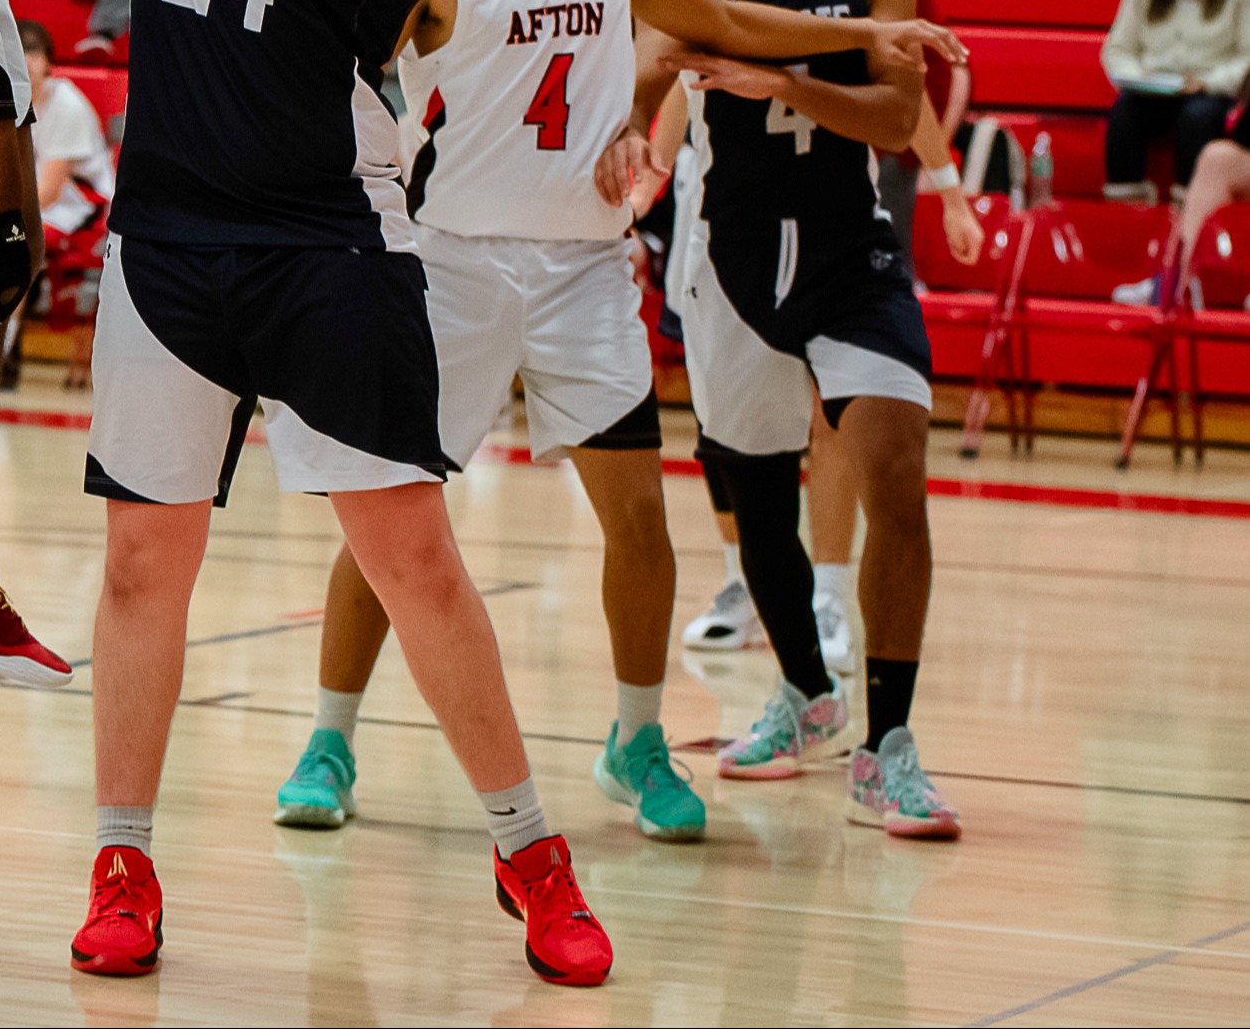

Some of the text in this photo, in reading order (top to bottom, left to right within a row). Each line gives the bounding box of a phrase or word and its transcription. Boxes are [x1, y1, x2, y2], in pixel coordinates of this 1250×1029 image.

[506, 2, 604, 45] AFTON
[523, 52, 575, 151] 4
[765, 63, 818, 156] 4
